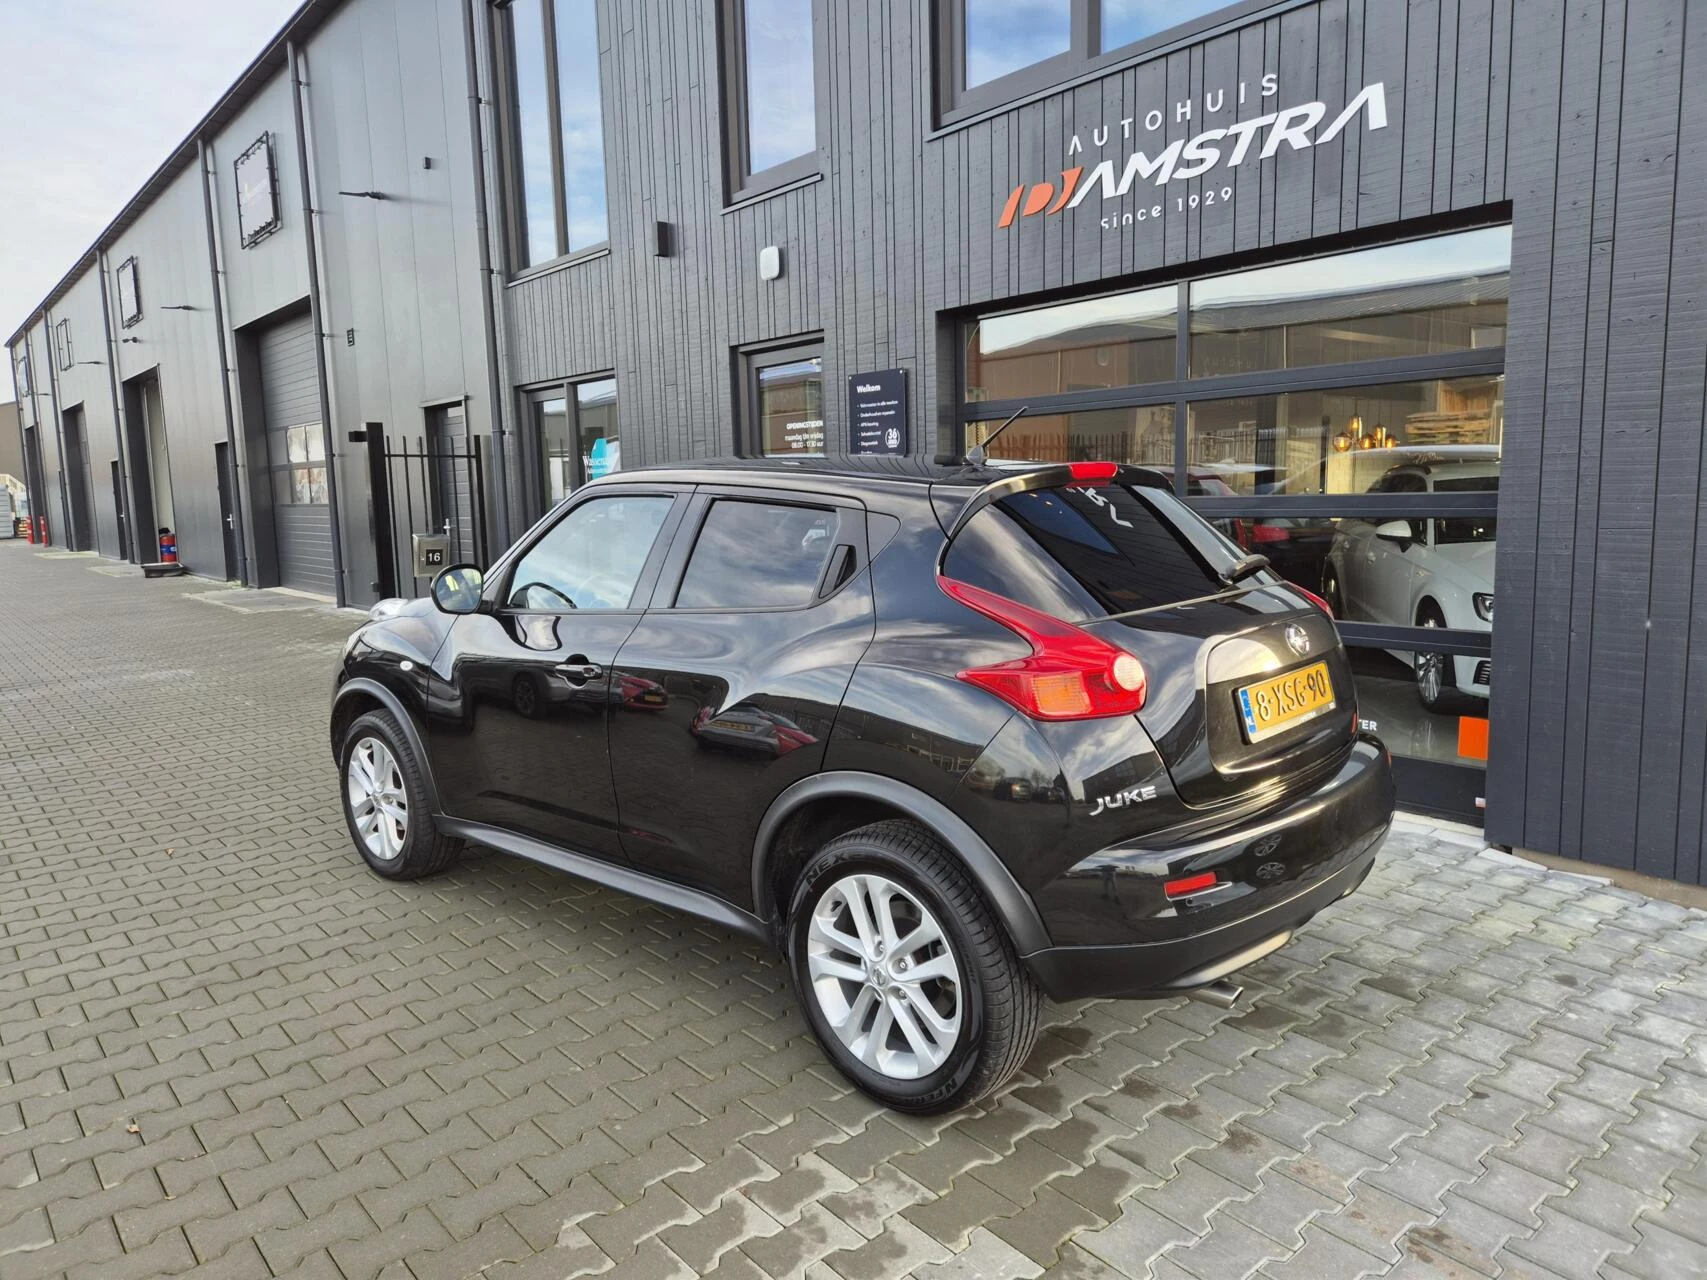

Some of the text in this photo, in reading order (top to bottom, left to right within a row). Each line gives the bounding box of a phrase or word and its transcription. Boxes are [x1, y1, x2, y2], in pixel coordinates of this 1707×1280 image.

[1069, 73, 1279, 156] AUTOHUIS
[1100, 187, 1233, 229] since 1929
[856, 384, 881, 393] Welkom
[888, 428, 899, 440] 36
[427, 552, 441, 562] 16
[1256, 669, 1328, 722] 8-XSG-90
[1089, 785, 1157, 816] JUKE
